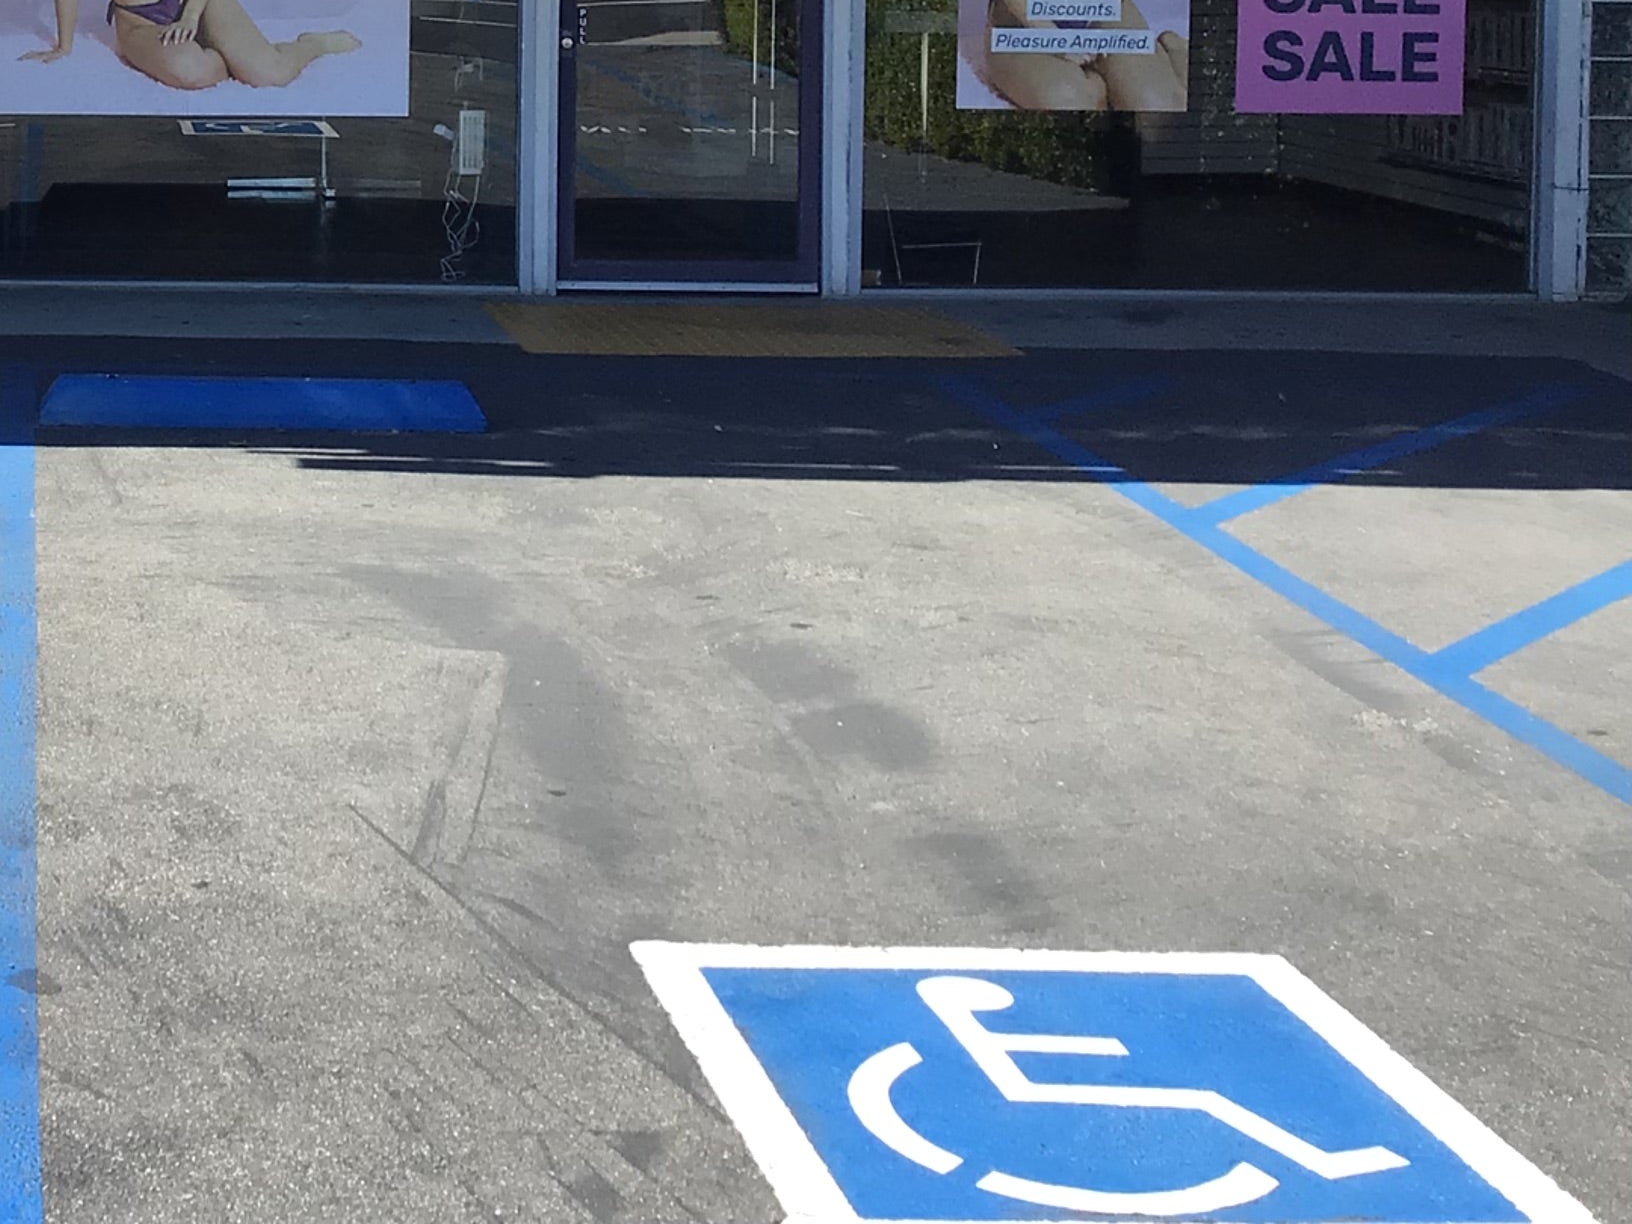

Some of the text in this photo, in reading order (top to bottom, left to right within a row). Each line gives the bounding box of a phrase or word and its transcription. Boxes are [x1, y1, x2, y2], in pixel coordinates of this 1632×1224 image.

[1031, 1, 1116, 17] Discounts.
[995, 33, 1150, 51] Pleasure Amplified.
[1261, 30, 1440, 82] SALE
